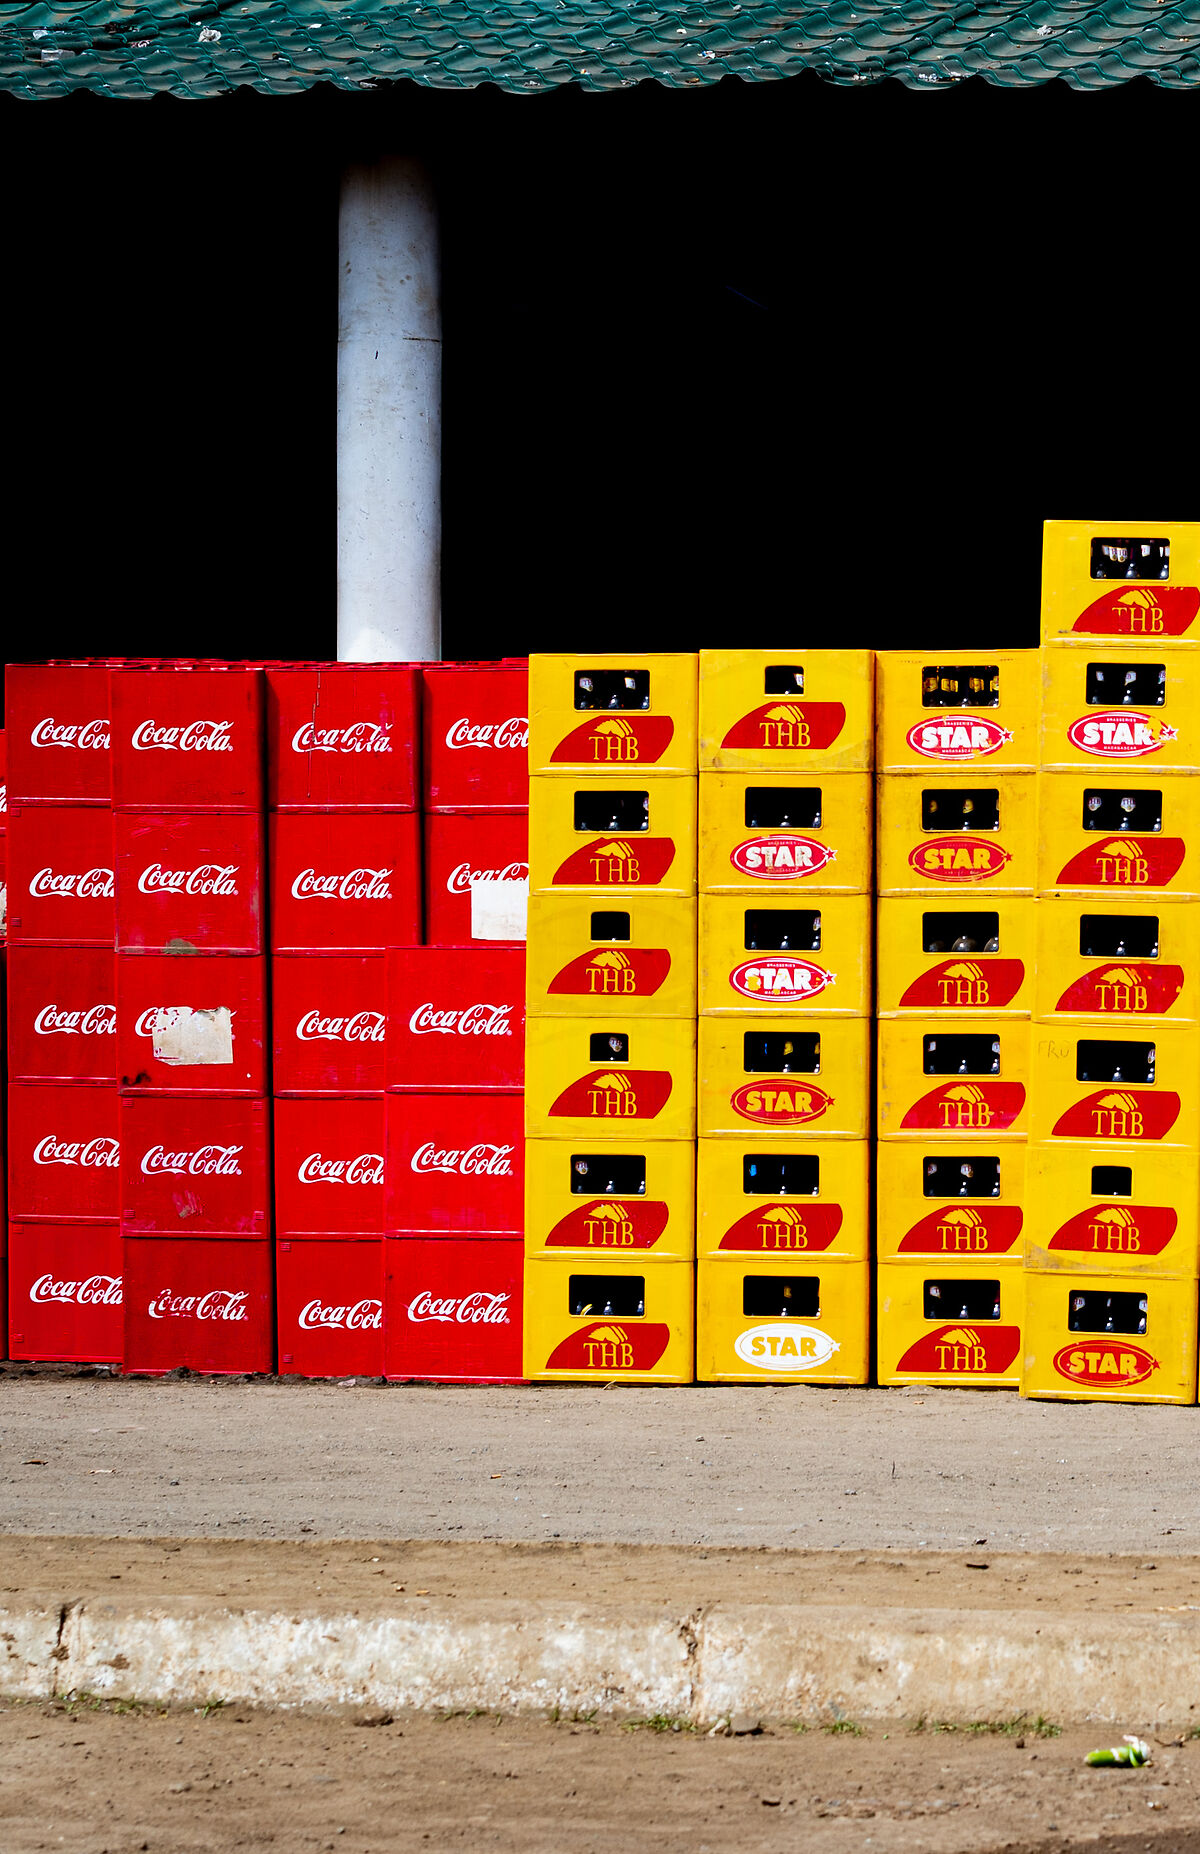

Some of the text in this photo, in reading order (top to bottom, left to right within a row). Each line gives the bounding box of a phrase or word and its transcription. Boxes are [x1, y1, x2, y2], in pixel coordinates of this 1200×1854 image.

[1112, 607, 1163, 632] THB
[31, 718, 110, 749] Coca-Col
[132, 720, 233, 751] Coca-Cola
[292, 722, 393, 752] Coca-Cola
[760, 722, 811, 747] THB
[921, 726, 990, 749] STAR
[1083, 722, 1154, 745] STAR
[589, 736, 639, 761] THB
[745, 845, 814, 868] STAR
[924, 848, 991, 869] STAR
[29, 868, 114, 898] Coca-Col
[138, 864, 239, 895] Coca-Cola
[590, 858, 640, 883] THB
[1096, 857, 1148, 883] THB
[292, 869, 393, 899] Coca-Cola
[586, 968, 636, 993] THB
[744, 968, 813, 991] STAR
[938, 979, 989, 1005] THB
[1095, 984, 1147, 1010] THB
[34, 1005, 116, 1035] Coca-Col
[296, 1010, 385, 1042] Coca-Col
[409, 1003, 513, 1035] Coca-Cola
[588, 1090, 637, 1117] THB
[746, 1093, 813, 1112] STAR
[939, 1102, 990, 1128] THB
[1091, 1110, 1144, 1136] THB
[141, 1146, 243, 1175] Coca-Cola
[298, 1153, 384, 1185] Coca-Col
[411, 1143, 514, 1175] Coca-Cola
[584, 1220, 634, 1246] THB
[757, 1224, 808, 1250] THB
[937, 1226, 988, 1251] THB
[1088, 1225, 1140, 1252] THB
[149, 1289, 249, 1321] Coca-Cola
[299, 1300, 382, 1330] Coca-Col
[408, 1291, 511, 1323] Coca-Cola
[583, 1342, 634, 1368] THB
[751, 1336, 817, 1357] STAR
[935, 1346, 987, 1371] THB
[1068, 1352, 1138, 1375] STAR
